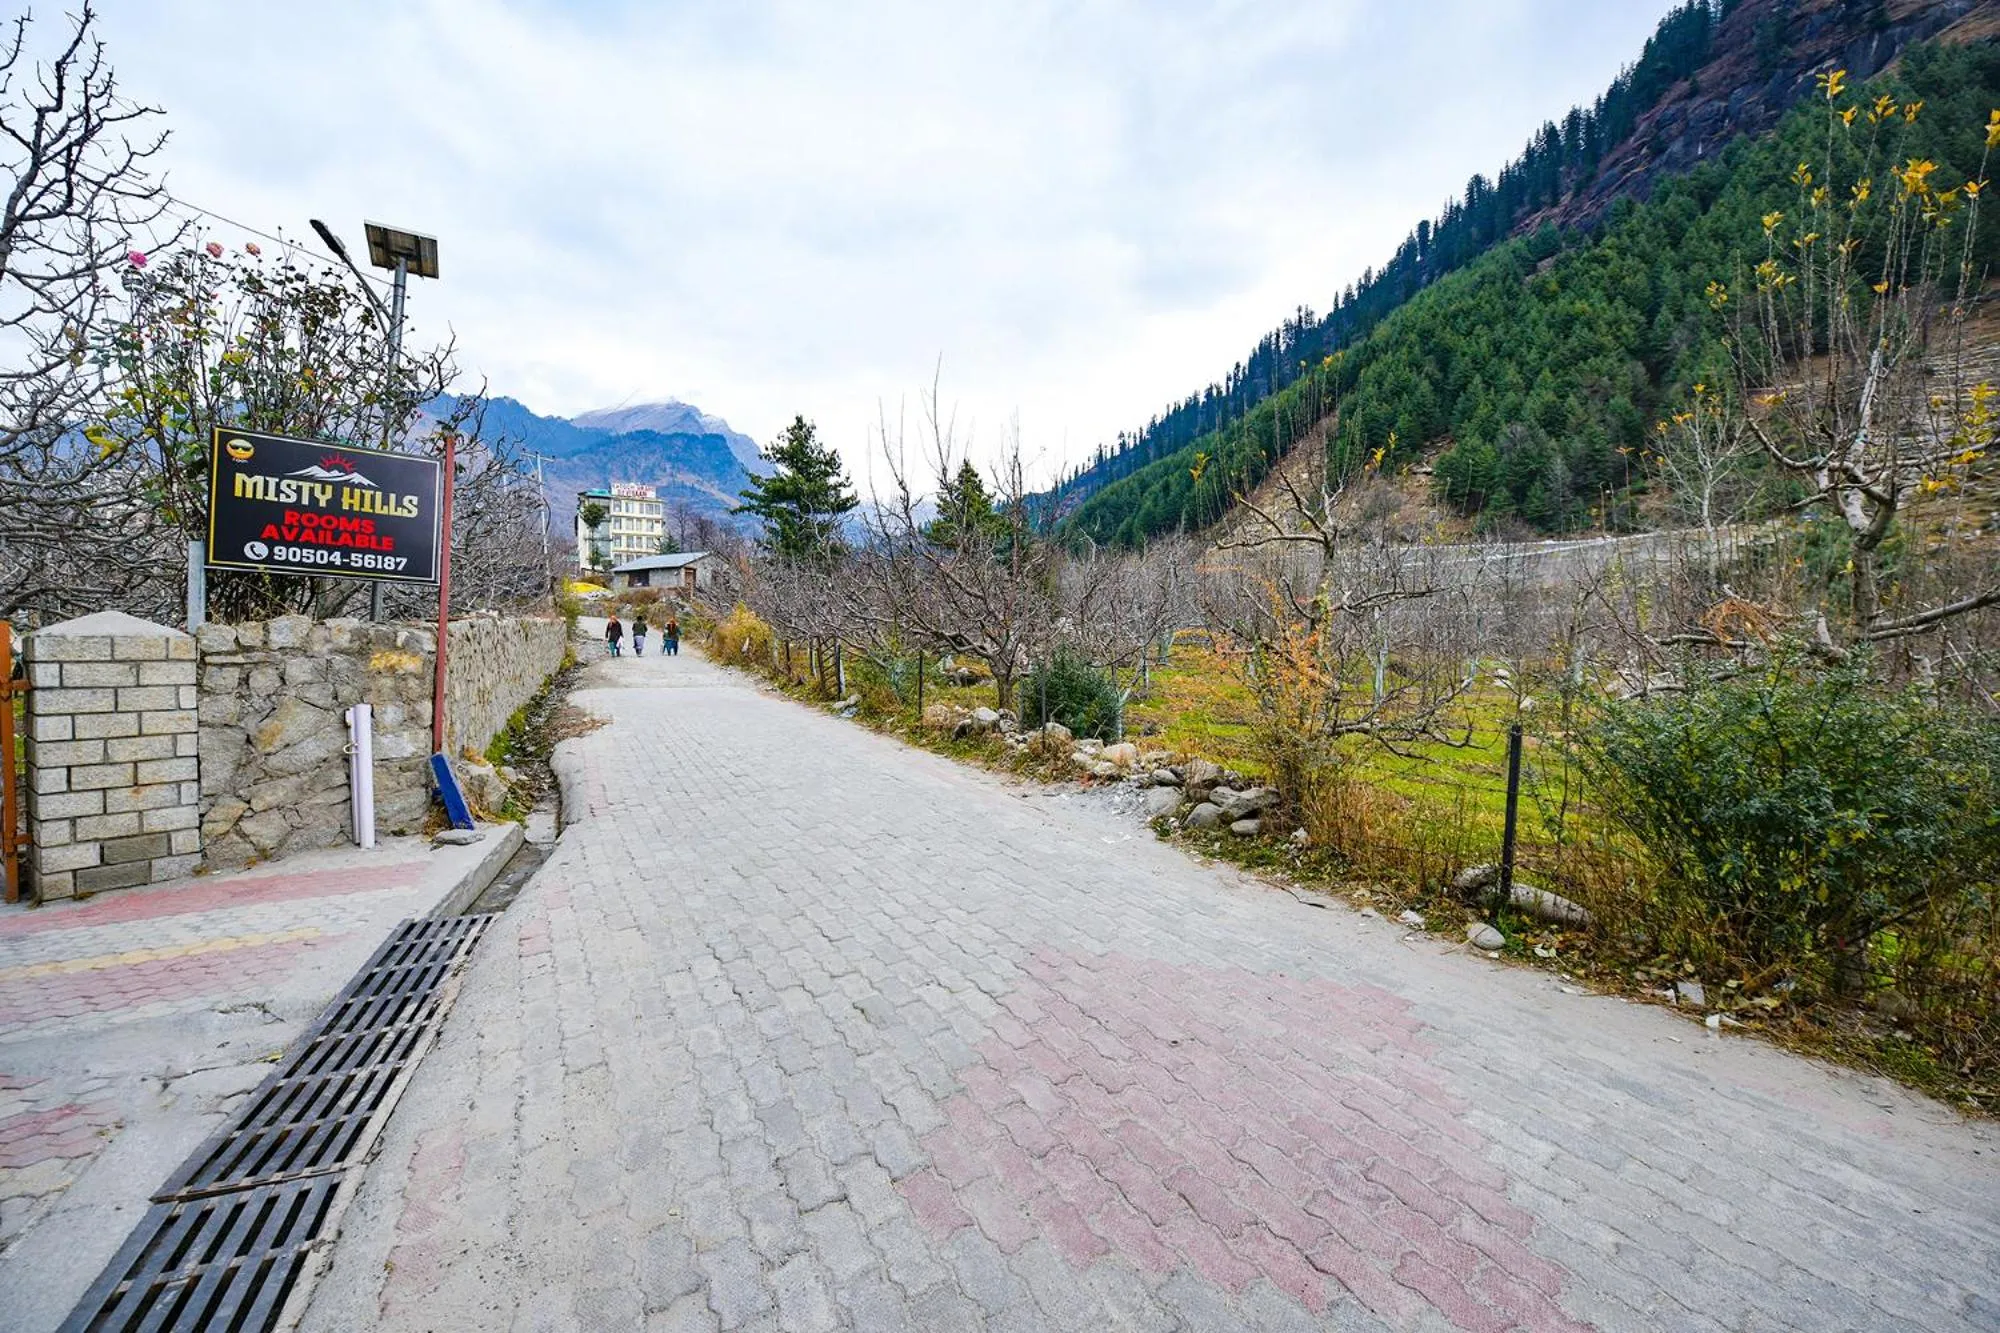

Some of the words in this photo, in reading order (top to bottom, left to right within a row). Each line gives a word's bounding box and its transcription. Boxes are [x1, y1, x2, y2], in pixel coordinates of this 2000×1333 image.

[234, 472, 332, 507] MISTY
[342, 486, 418, 518] HILLS
[284, 510, 375, 534] ROOMS
[260, 524, 395, 550] AVAILABLE
[273, 546, 407, 571] 90504-56187
